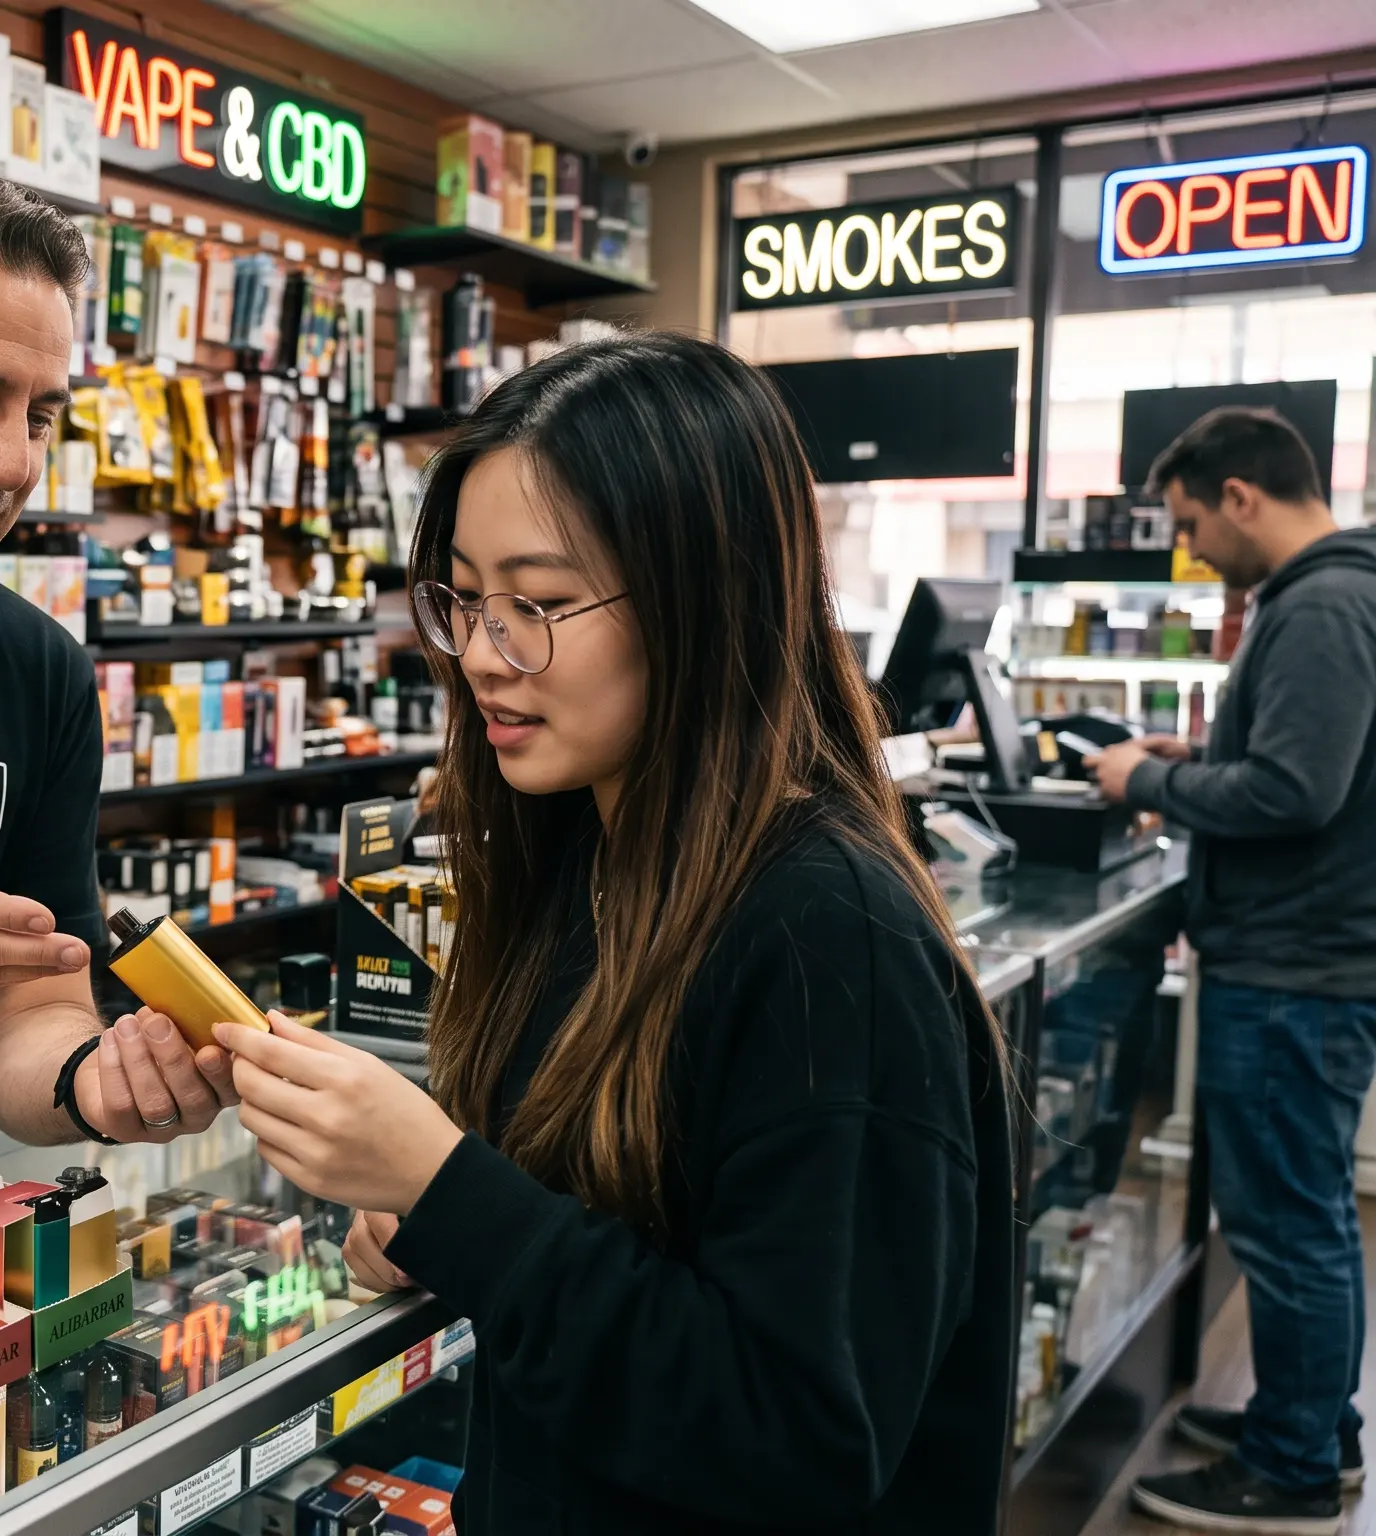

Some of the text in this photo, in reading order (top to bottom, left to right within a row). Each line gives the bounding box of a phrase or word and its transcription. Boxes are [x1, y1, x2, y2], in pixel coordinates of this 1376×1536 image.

[73, 29, 367, 210] VAPE & CBD
[741, 199, 1008, 301] SMOKES
[1114, 160, 1352, 260] OPEN
[48, 1292, 125, 1344] ALIBARBAR
